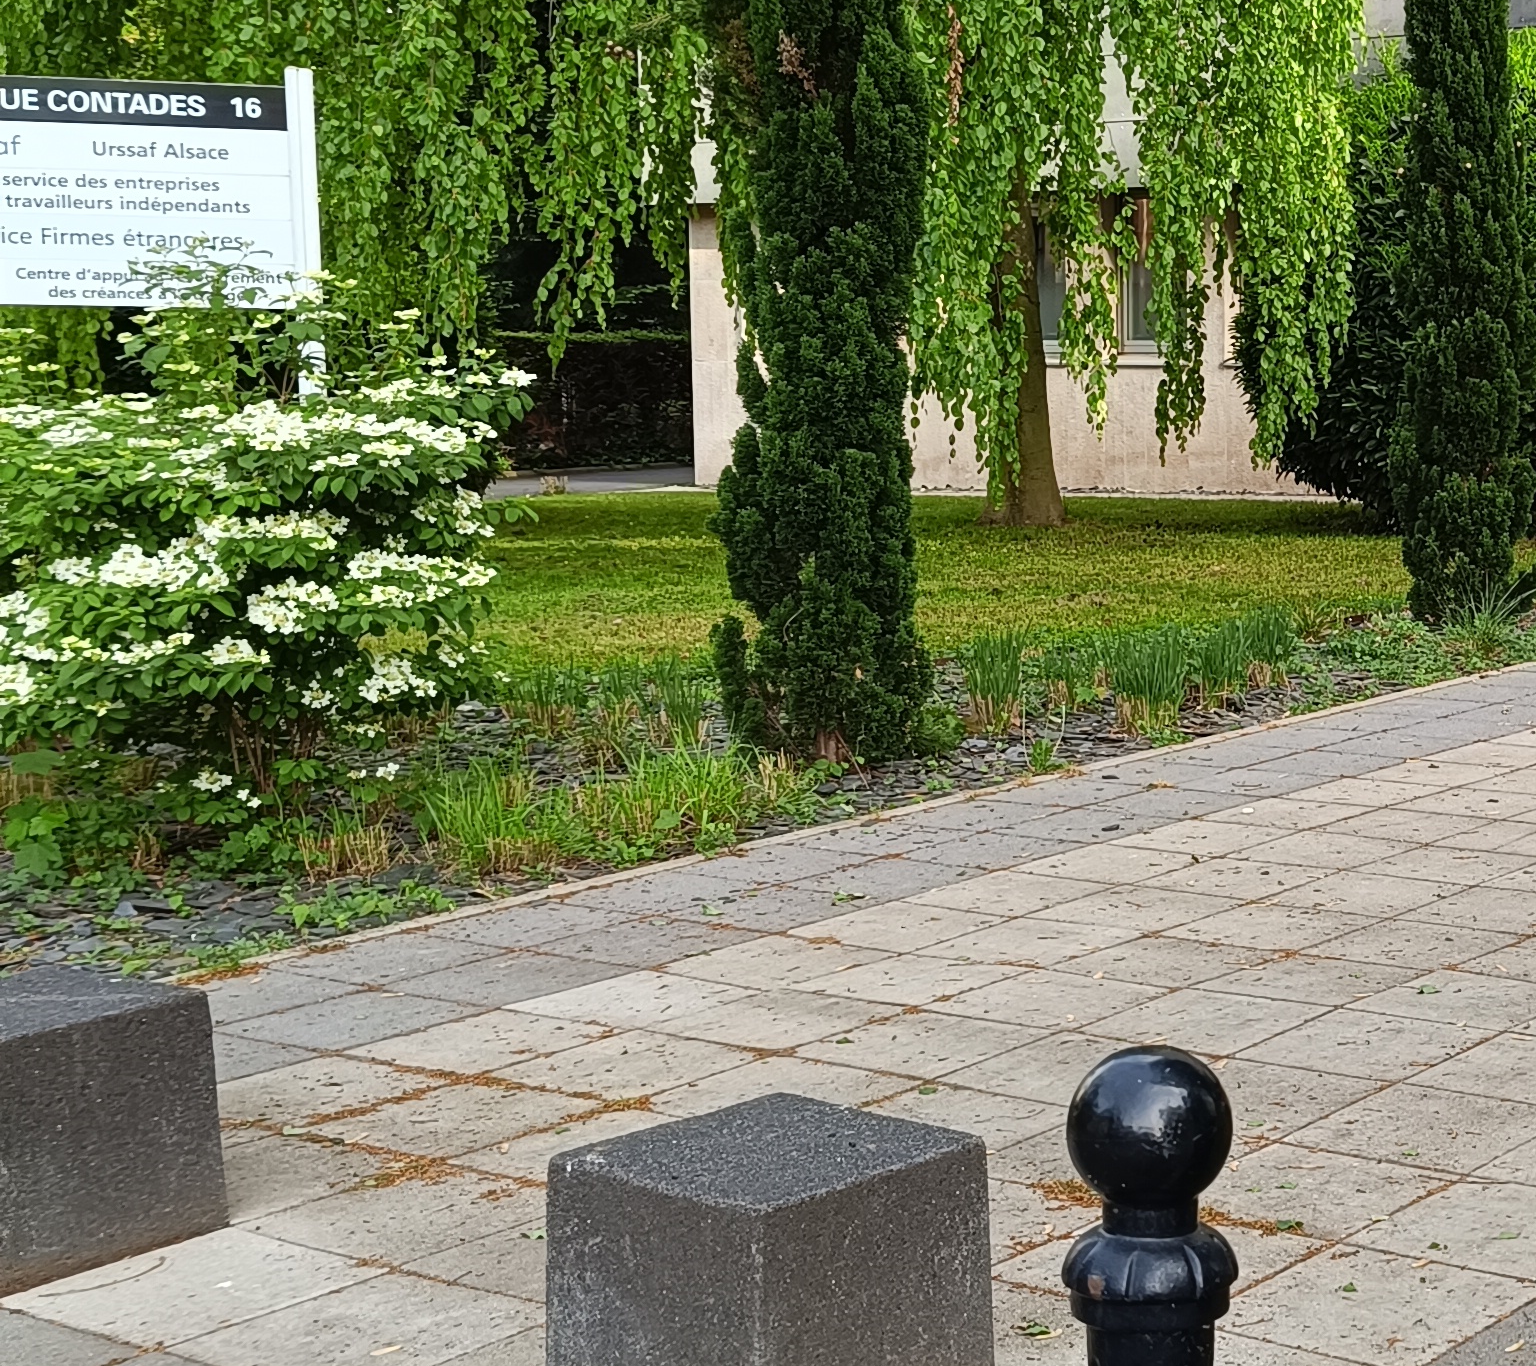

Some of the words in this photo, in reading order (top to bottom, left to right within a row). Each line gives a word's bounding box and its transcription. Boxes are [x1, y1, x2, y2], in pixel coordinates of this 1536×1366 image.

[47, 89, 206, 117] CONTADES
[230, 97, 262, 118] 16
[92, 141, 157, 158] Urssaf
[164, 142, 229, 160] Alsace
[2, 172, 68, 187] service
[75, 173, 107, 188] des
[114, 176, 220, 192] entreprises
[5, 194, 112, 210] travailleurs
[120, 196, 251, 214] indépendants
[41, 227, 115, 245] Firmes
[16, 267, 71, 280] Centre
[48, 286, 77, 299] des
[82, 287, 153, 300] créances
